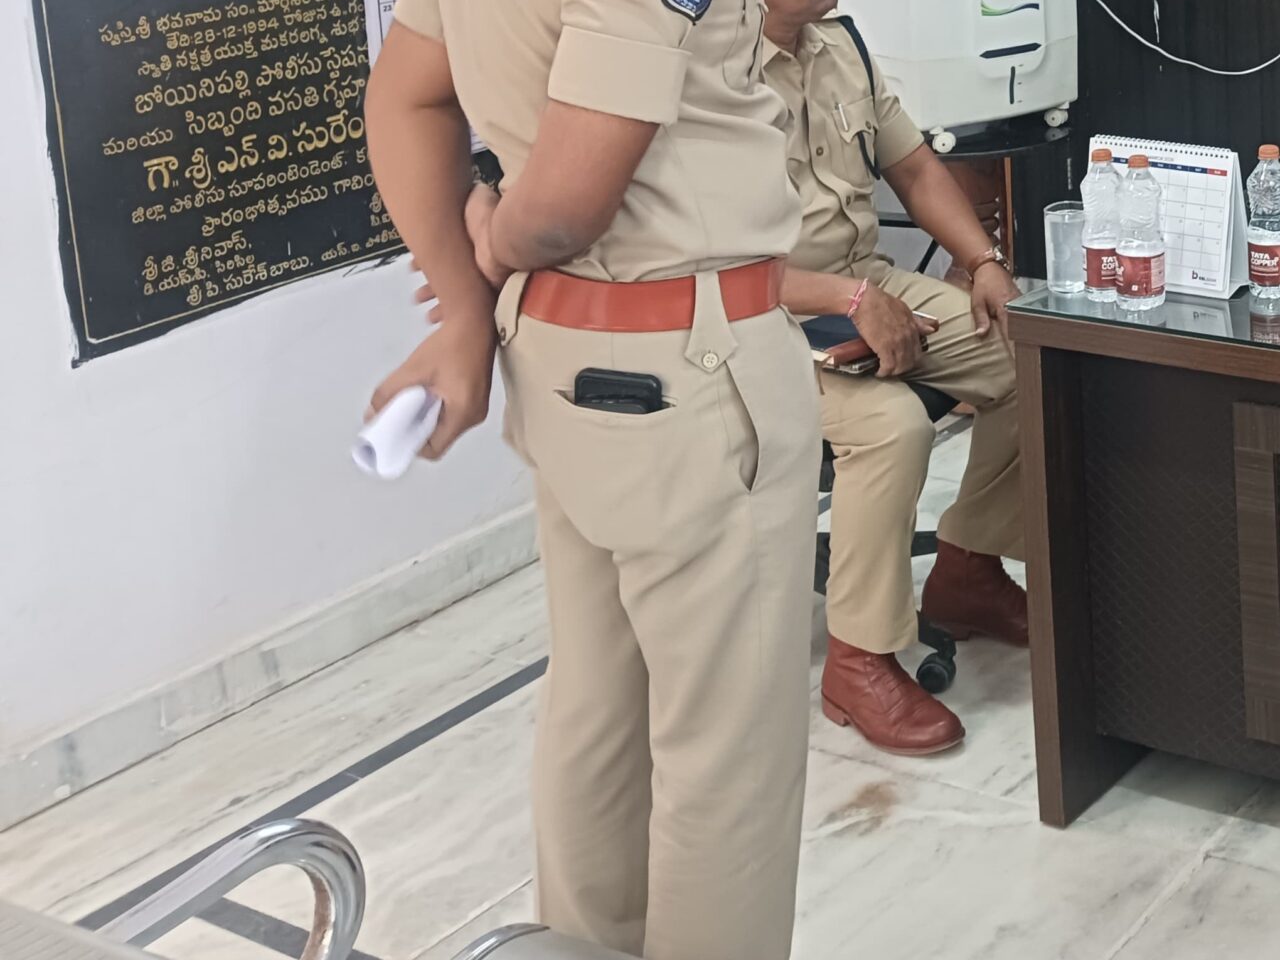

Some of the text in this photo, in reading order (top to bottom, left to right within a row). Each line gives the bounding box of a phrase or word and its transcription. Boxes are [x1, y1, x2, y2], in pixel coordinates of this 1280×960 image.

[283, 6, 327, 26] రోజున
[137, 55, 172, 78] స్వాతి
[134, 69, 252, 114] బోయినిపల్లి
[102, 127, 174, 156] మరియు
[184, 101, 262, 137] సిబ్బంది
[184, 146, 213, 189] శ్రీ
[131, 203, 167, 225] జిల్లా
[169, 187, 226, 215] పోలీసు
[200, 173, 375, 237] ప్రారంభోత్సవము గావిం
[141, 255, 159, 281] శ్రీ
[1250, 251, 1271, 260] TATA
[1250, 258, 1277, 267] COPPER
[186, 285, 203, 306] శ్రీ
